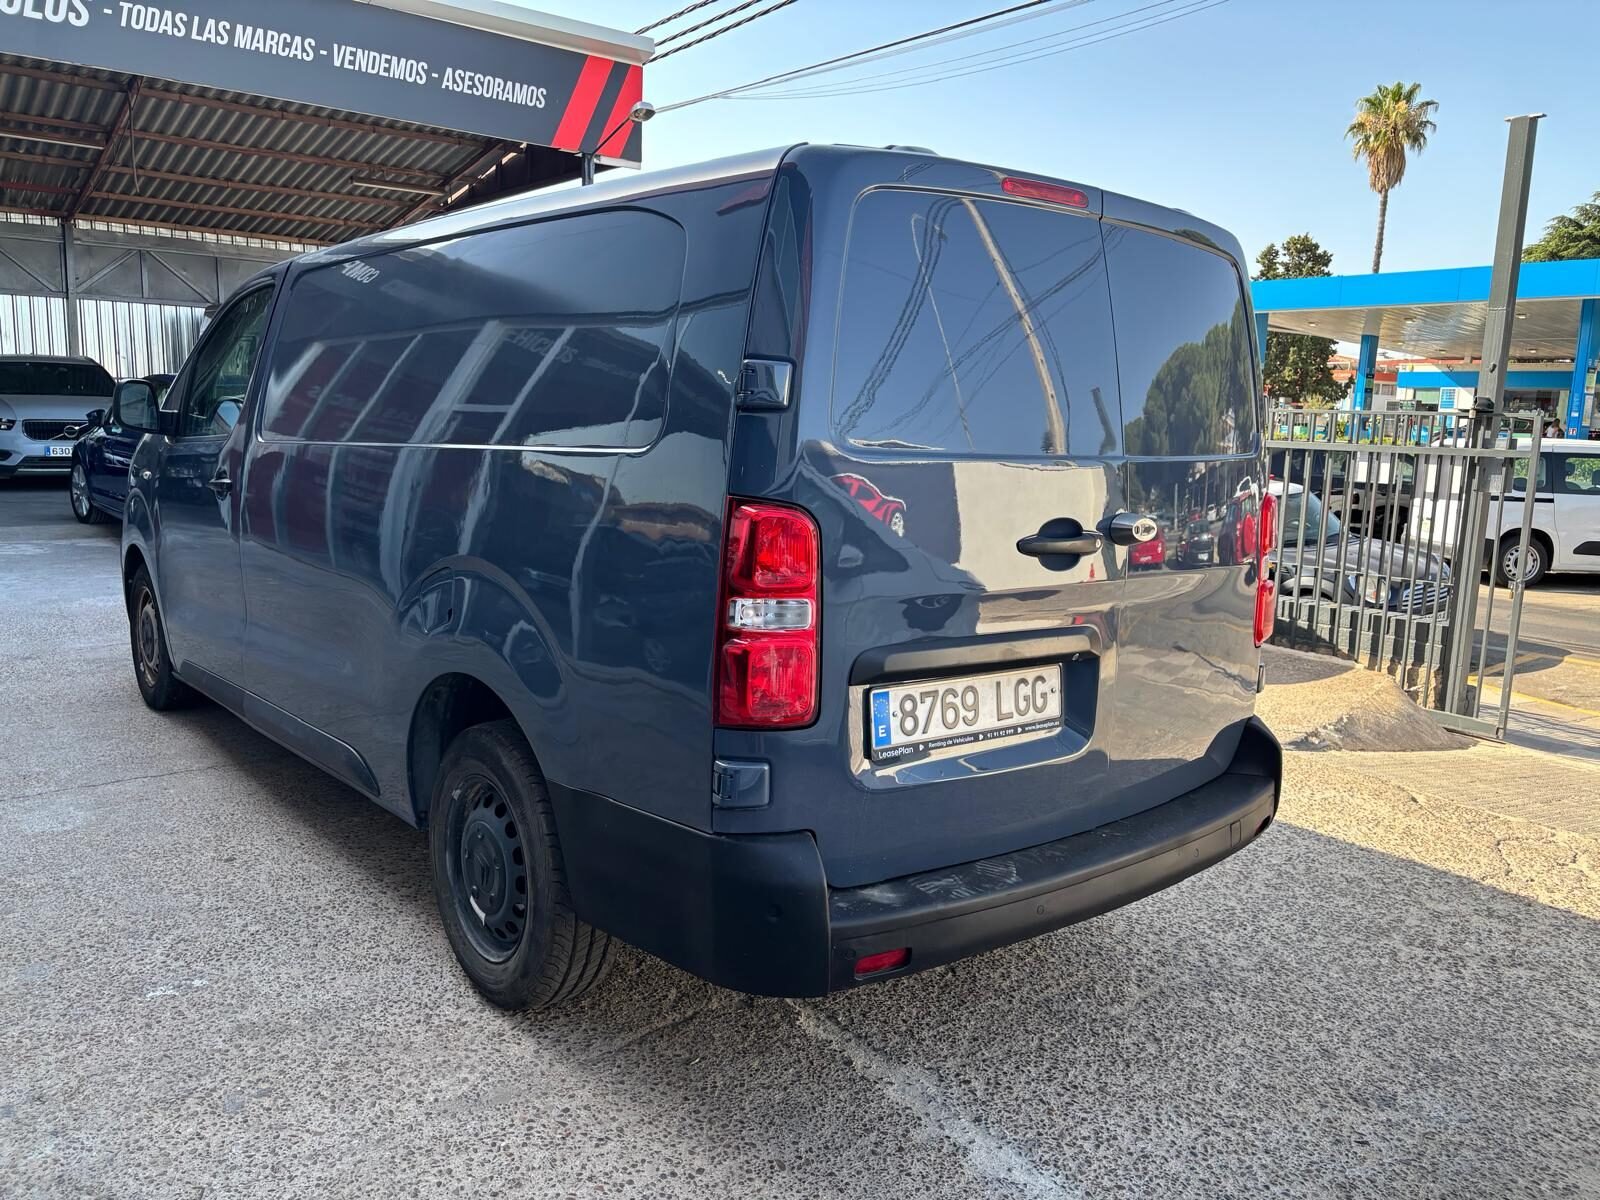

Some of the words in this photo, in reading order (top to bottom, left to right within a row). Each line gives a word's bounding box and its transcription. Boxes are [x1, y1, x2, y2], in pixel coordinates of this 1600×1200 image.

[119, 1, 188, 37] TODAS
[191, 15, 231, 46] LAS
[234, 23, 316, 62] MARCAS
[333, 43, 428, 85] VENDEMOS
[441, 67, 547, 109] ASESORAMOS
[899, 685, 981, 737] 8769
[995, 675, 1048, 722] LGG
[878, 725, 887, 737] E
[878, 746, 914, 759] LeasePlan
[928, 741, 947, 749] Renting
